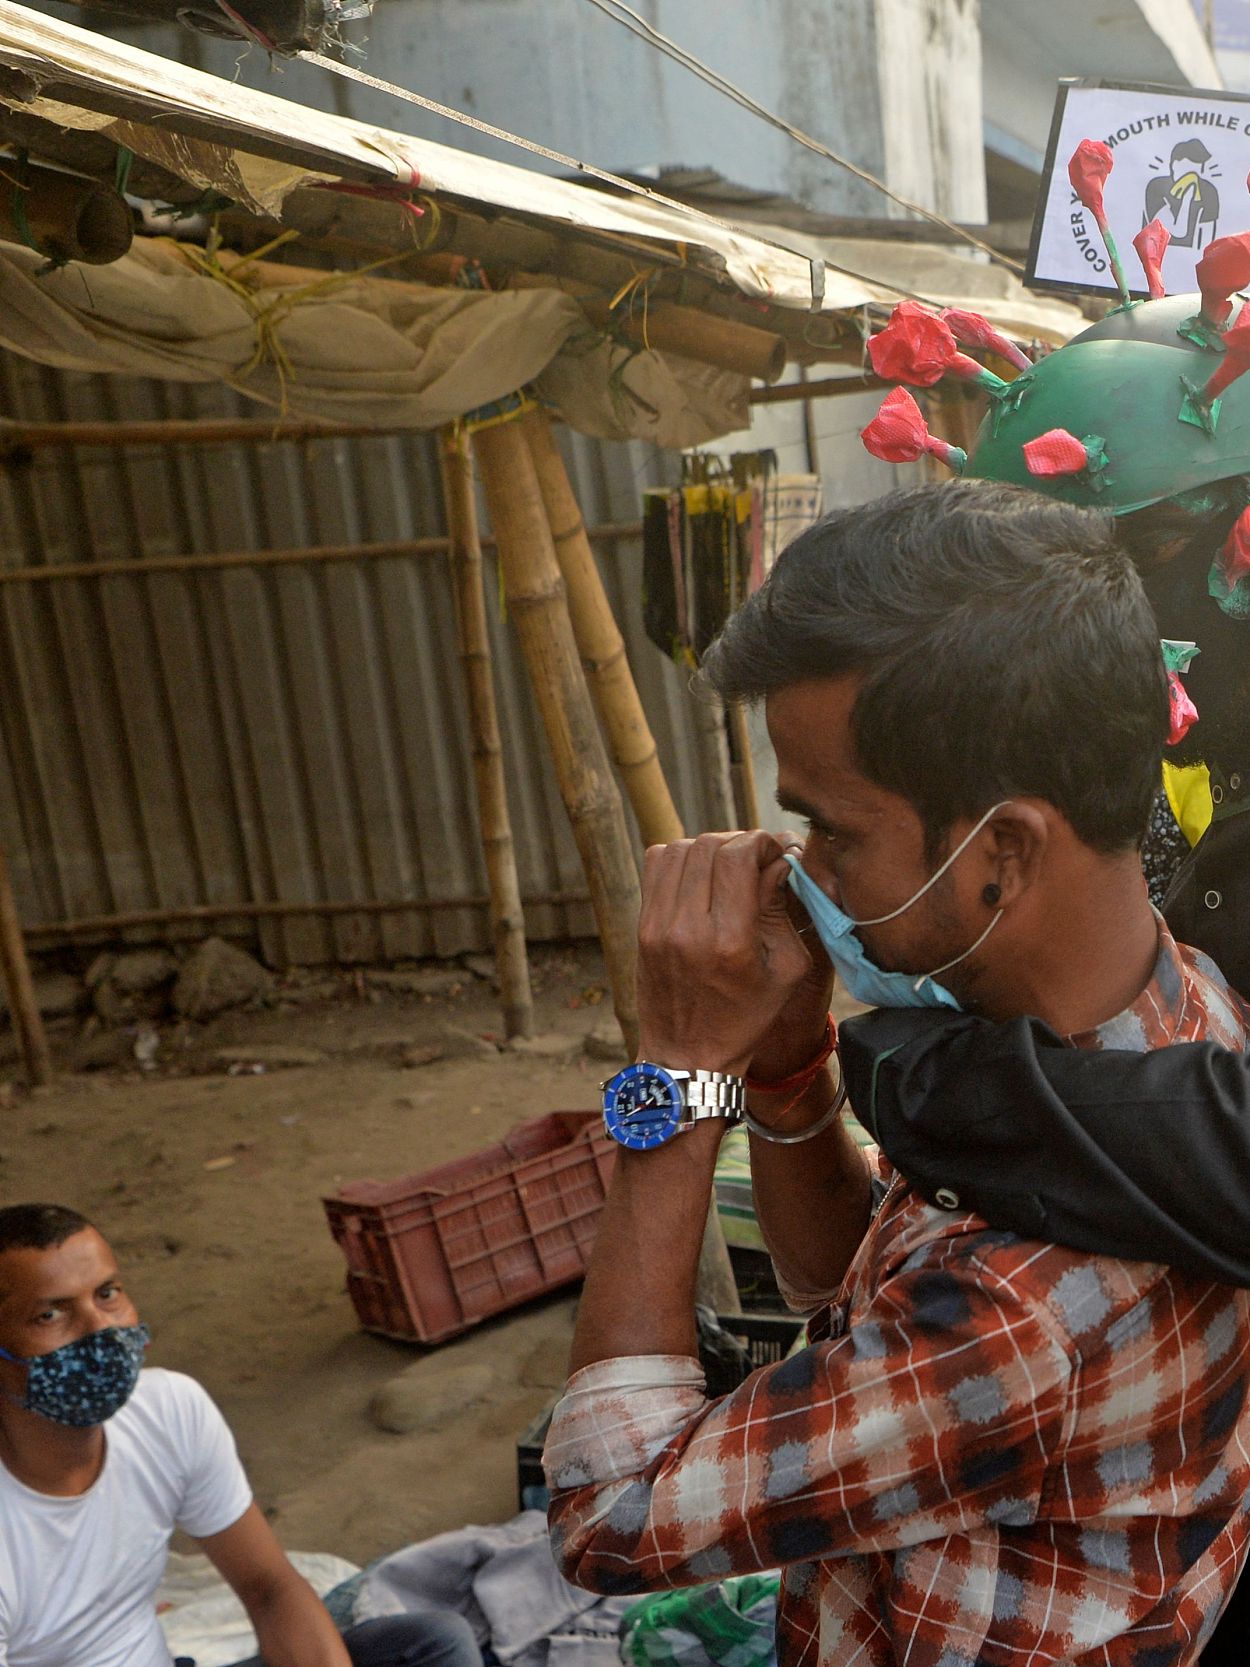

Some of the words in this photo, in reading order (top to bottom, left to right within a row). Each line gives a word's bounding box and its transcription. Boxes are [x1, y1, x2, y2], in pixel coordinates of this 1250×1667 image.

[1071, 211, 1106, 273] COVER
[1103, 113, 1171, 149] MOUTH
[1177, 111, 1240, 131] WHILE
